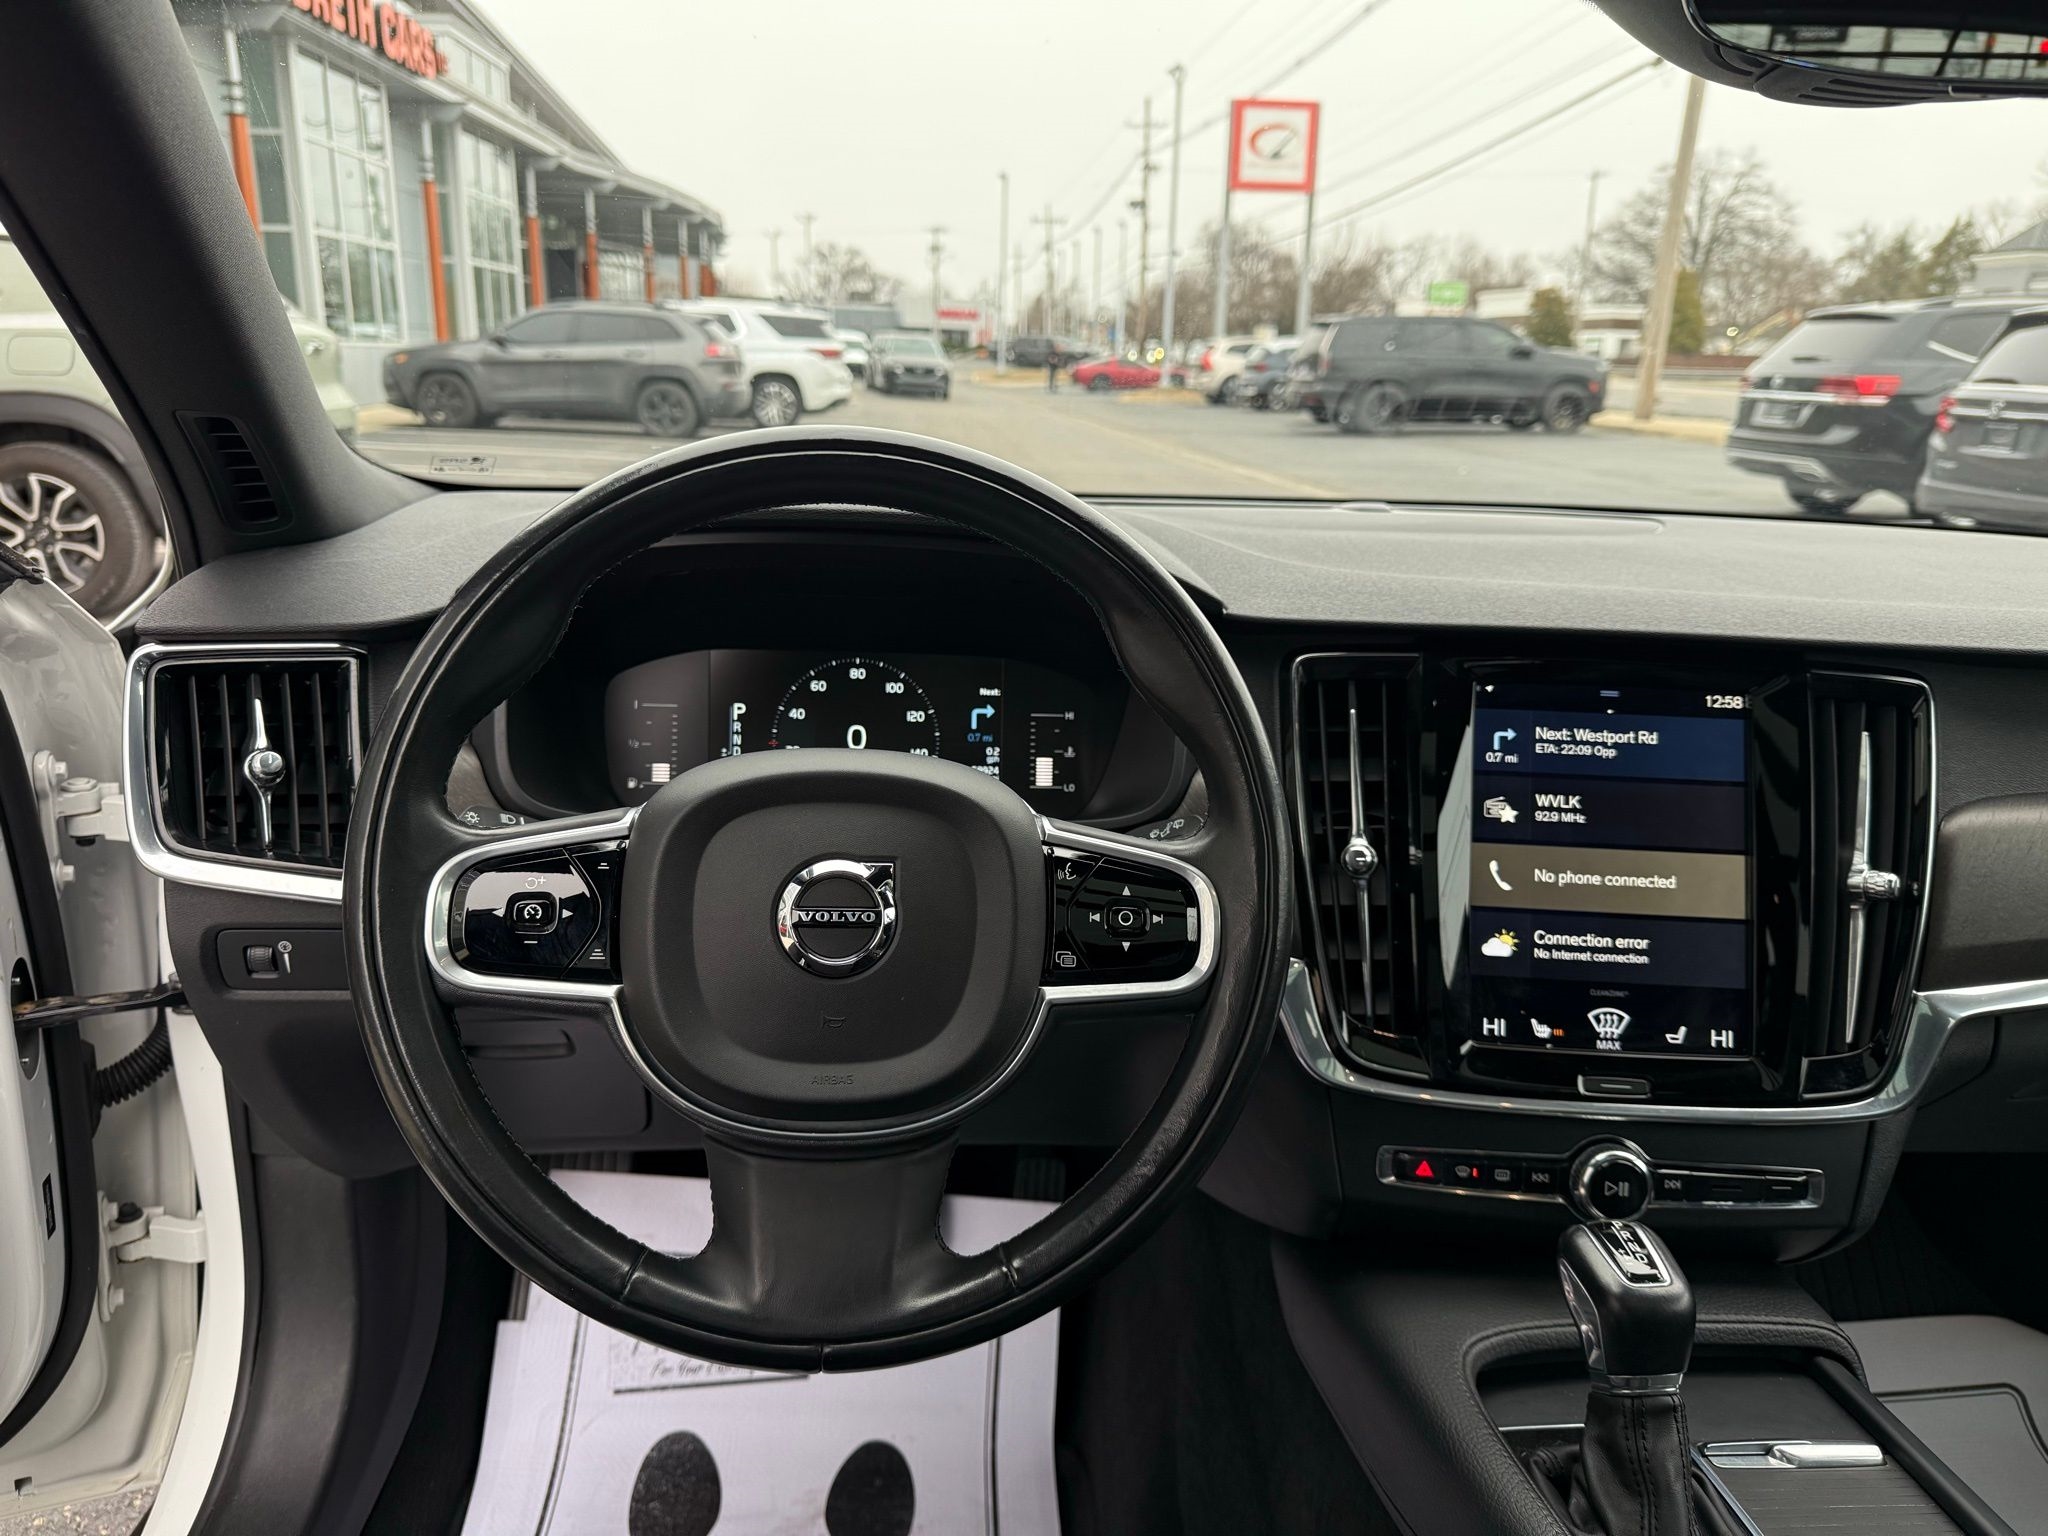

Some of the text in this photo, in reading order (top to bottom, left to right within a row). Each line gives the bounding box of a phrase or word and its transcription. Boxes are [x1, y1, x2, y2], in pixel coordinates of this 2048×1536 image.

[380, 3, 437, 79] CARS
[849, 668, 867, 680] 80
[810, 680, 827, 692] 60
[885, 682, 904, 694] 100
[979, 687, 1001, 697] Next:
[1704, 695, 1744, 709] 12:58
[788, 708, 806, 720] 40
[906, 710, 925, 722] 120
[846, 724, 867, 749] 0
[1535, 726, 1659, 746] Next: Westport Rd
[1485, 752, 1518, 763] 0.7 mi
[1535, 743, 1617, 759] ETA: 22:09 Opp
[1535, 794, 1582, 809] WVLK
[1534, 811, 1588, 824] 92.9 MHz
[1534, 868, 1677, 889] No phone connected
[800, 911, 876, 922] VOLVO
[1534, 930, 1650, 950] Connection error
[1534, 948, 1650, 964] No Internet connection
[1483, 1017, 1507, 1037] HI
[1596, 1040, 1622, 1051] MAX
[1710, 1029, 1734, 1048] HI
